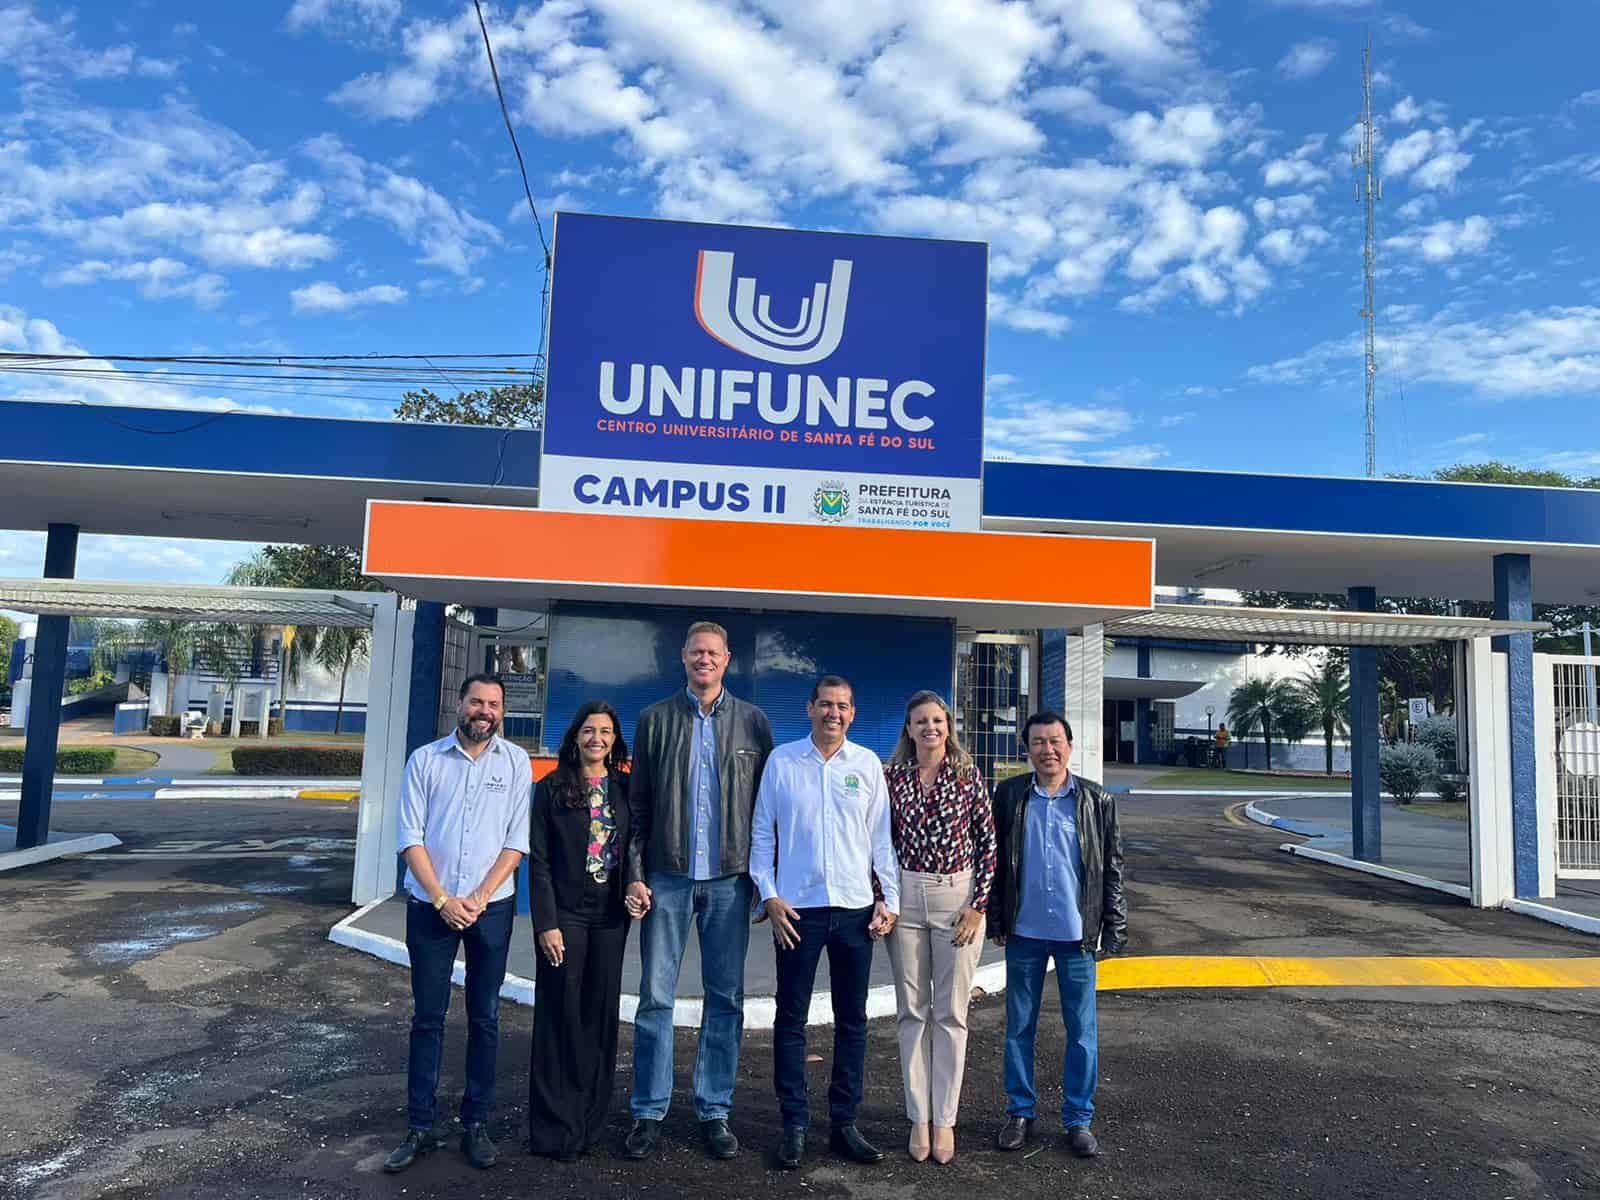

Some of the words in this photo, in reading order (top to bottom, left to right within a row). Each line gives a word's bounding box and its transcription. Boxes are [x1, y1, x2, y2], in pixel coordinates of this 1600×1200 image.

[599, 360, 936, 432] UNIFUNEC
[596, 419, 657, 434] CENTRO
[663, 424, 774, 441] UNIVERSITÁRIO
[780, 430, 798, 442] DE
[804, 432, 852, 446] SANTA
[859, 432, 875, 447] FÉ
[881, 438, 902, 448] DO
[908, 438, 935, 450] SUL
[573, 474, 750, 512] CAMPUS
[763, 484, 786, 514] II
[859, 484, 951, 500] PREFEITURA
[858, 505, 894, 516] SANTA
[897, 506, 909, 517] FÉ
[912, 508, 927, 518] DO
[930, 509, 951, 519] SUL
